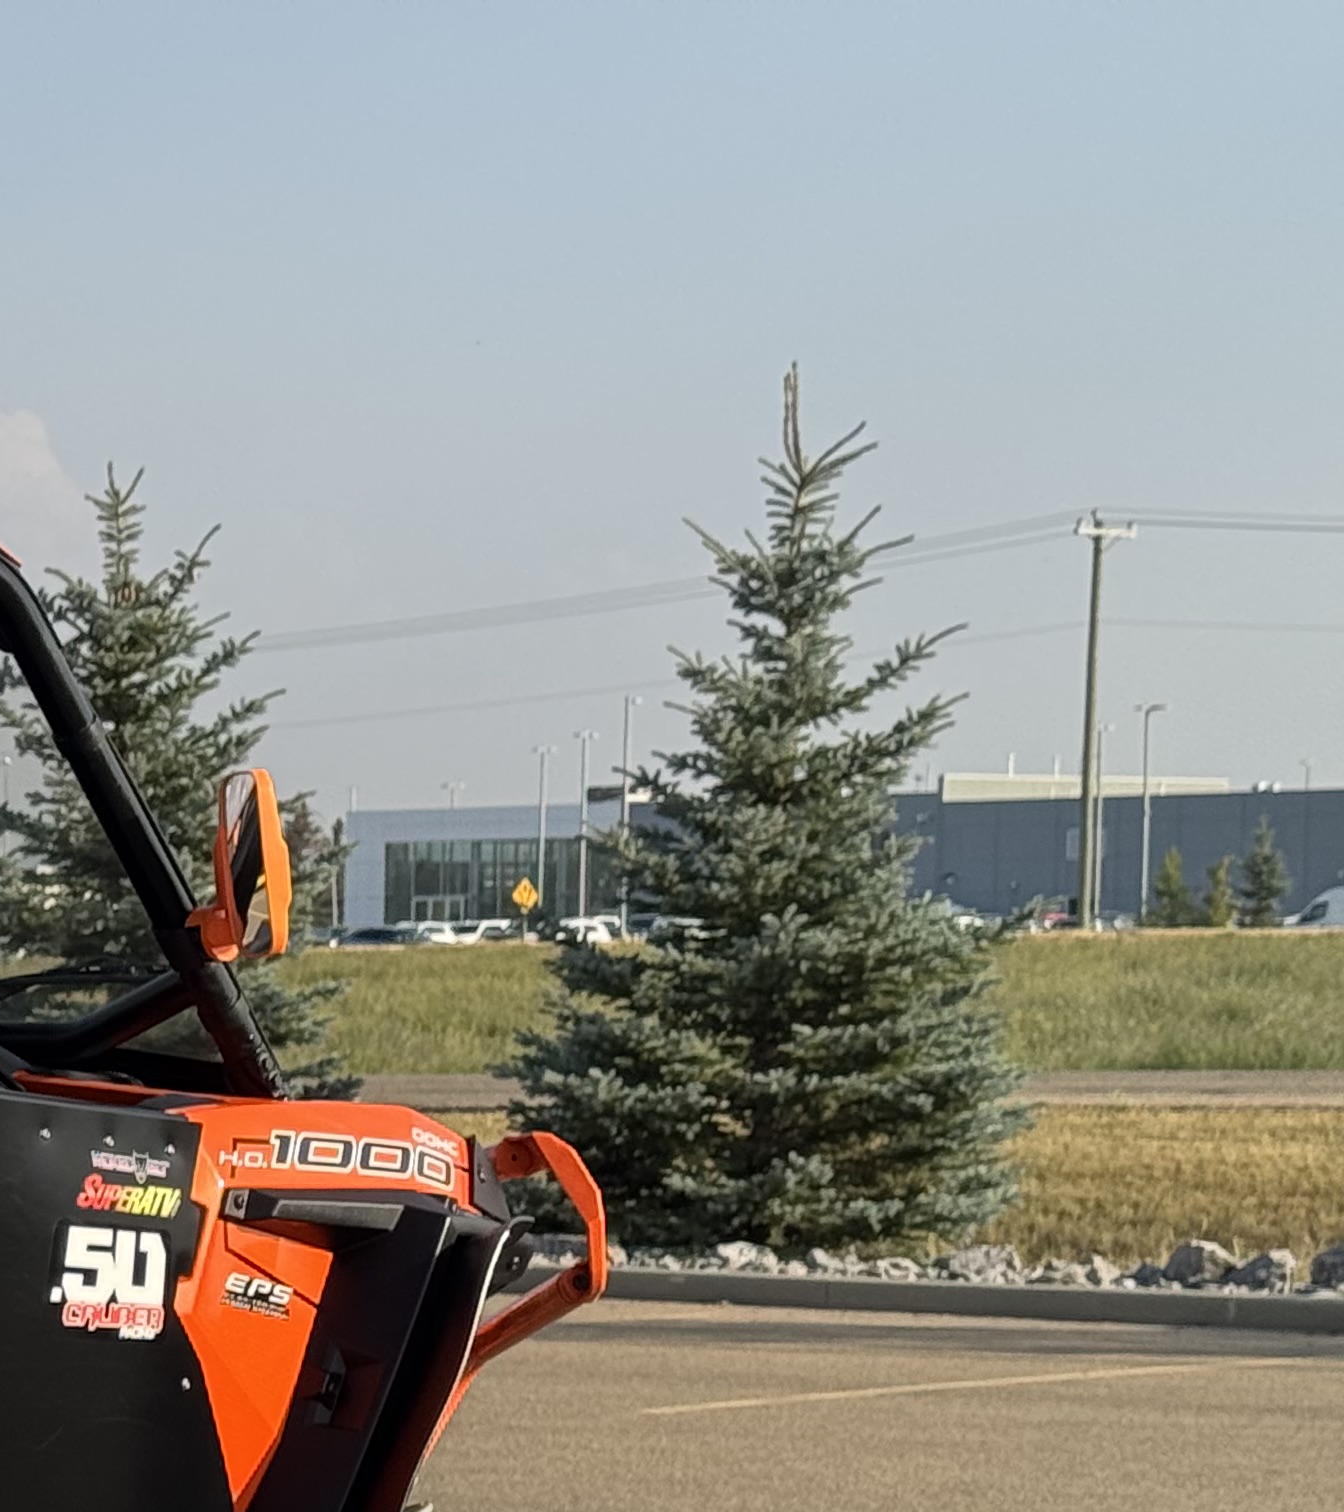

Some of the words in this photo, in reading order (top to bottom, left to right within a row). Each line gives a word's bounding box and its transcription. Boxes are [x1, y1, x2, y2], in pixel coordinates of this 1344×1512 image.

[218, 1150, 268, 1169] H.O.
[269, 1129, 455, 1192] 1000
[224, 1271, 294, 1306] EPS
